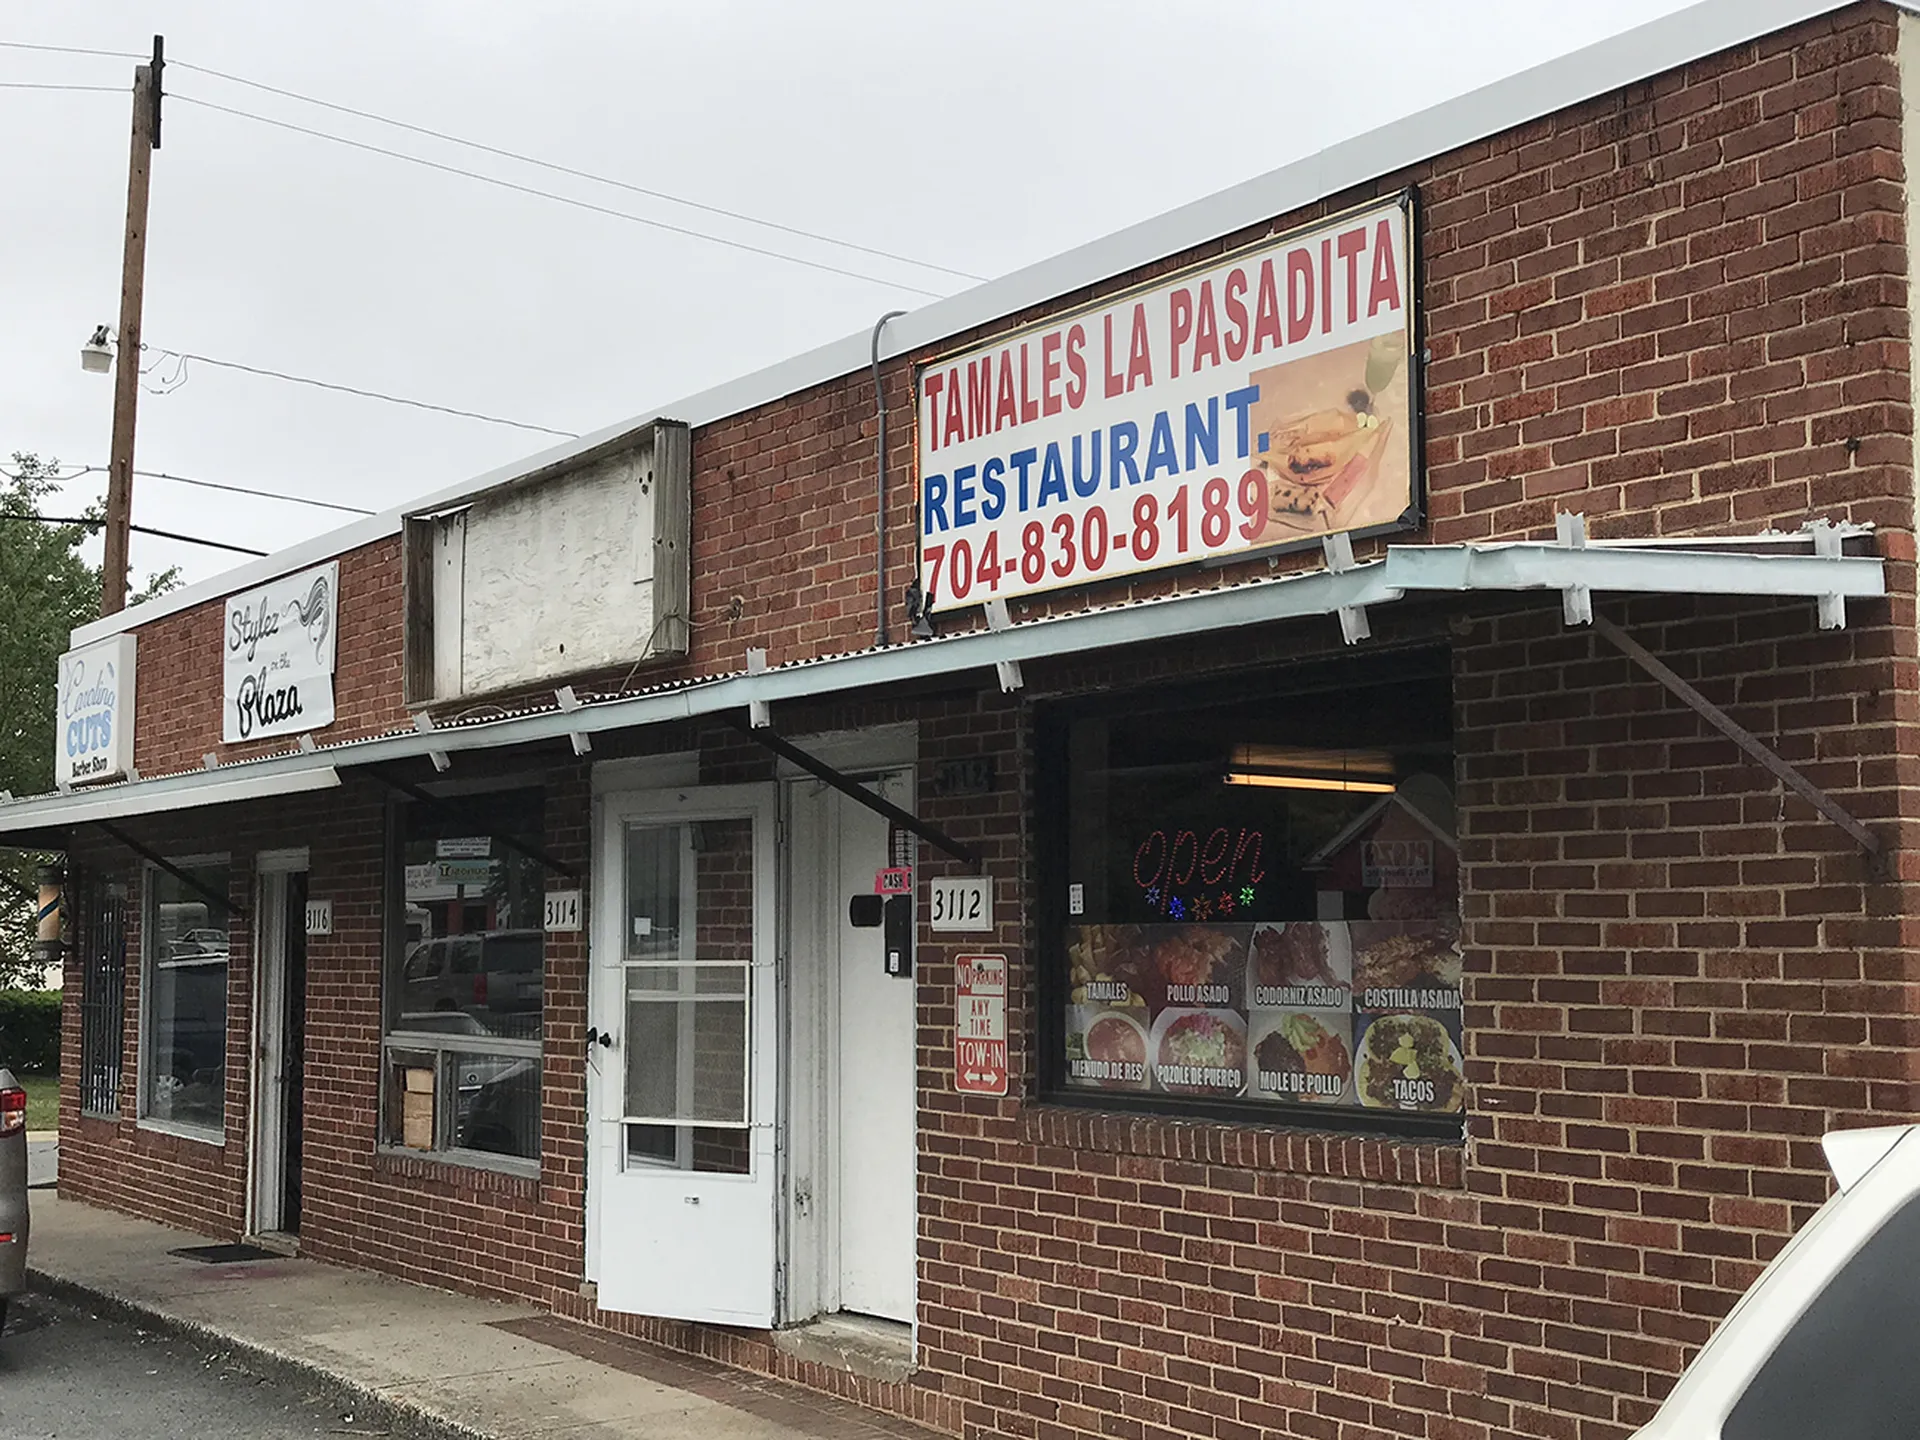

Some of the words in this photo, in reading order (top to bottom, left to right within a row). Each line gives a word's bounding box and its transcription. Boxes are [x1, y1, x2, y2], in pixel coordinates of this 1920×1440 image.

[924, 324, 1087, 452] TAMALES
[1103, 302, 1153, 399] LA
[1170, 218, 1400, 379] PASADITA
[924, 384, 1270, 535] RESTAURANT.
[923, 468, 1269, 604] 704-830-8189
[229, 596, 279, 662] Stylez
[62, 660, 115, 720] Carolina
[237, 666, 303, 738] Plaza
[67, 709, 112, 757] CUTS
[883, 873, 903, 888] CASH
[1133, 827, 1265, 914] open
[546, 899, 576, 926] 3114
[933, 889, 981, 921] 3112
[306, 908, 328, 930] 3116
[957, 964, 971, 988] NO
[972, 968, 1003, 986] PARKING
[1086, 982, 1128, 1000] TAMALES
[1167, 984, 1195, 1002] POLLO
[1196, 985, 1229, 1003] ASADO
[1255, 986, 1306, 1005] CODORNIZ
[1306, 987, 1343, 1006] ASADO
[1364, 988, 1418, 1008] COSTILLA
[1419, 988, 1461, 1009] ASADA
[971, 1000, 990, 1016] ANY
[970, 1019, 990, 1036] TIME
[958, 1041, 1004, 1068] TOW-IN
[1071, 1059, 1110, 1079] MENUDO
[1111, 1062, 1123, 1080] DE
[1124, 1063, 1143, 1081] RES
[1157, 1065, 1190, 1084] POZOLE
[1190, 1067, 1203, 1085] DE
[1204, 1068, 1241, 1088] PUERCO
[1260, 1071, 1289, 1092] MOLE
[1290, 1073, 1305, 1092] DE
[1307, 1074, 1341, 1095] POLLO
[1393, 1080, 1434, 1102] TACOS
